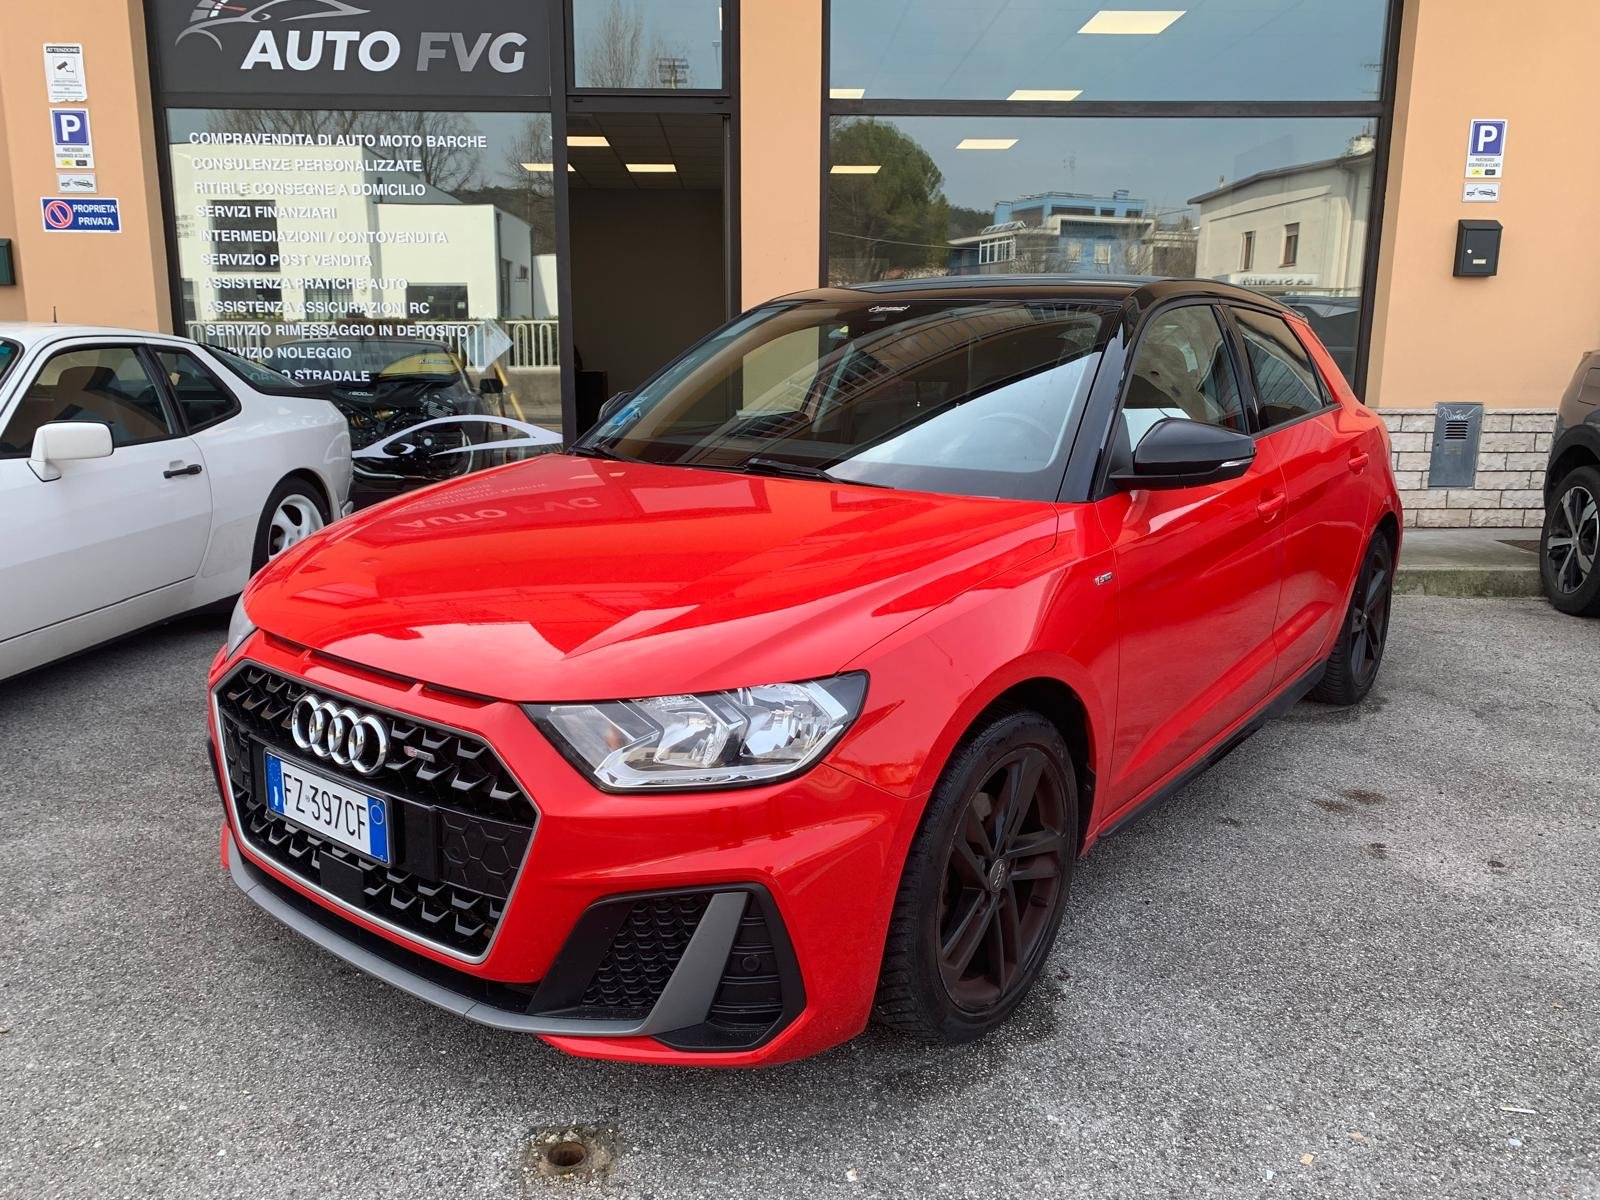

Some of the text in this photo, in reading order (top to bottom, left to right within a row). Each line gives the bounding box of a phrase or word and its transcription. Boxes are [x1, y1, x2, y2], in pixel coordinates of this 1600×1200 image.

[240, 30, 528, 73] AUTO FVG
[60, 114, 81, 142] P
[189, 132, 488, 148] COMPRAVENDITA DI AUTO MOTO BARCHE
[1477, 125, 1498, 152] P
[191, 157, 423, 172] CONSULENZE PERSONALIZZATE
[240, 183, 250, 195] E
[254, 183, 336, 196] CONSEGNE
[339, 183, 349, 196] A
[351, 183, 426, 196] DOMICILIO
[196, 205, 337, 219] SERVIZI FINANZIARI
[78, 216, 114, 226] PRIVATA
[200, 230, 326, 243] INTERMEDIAZIONI
[336, 231, 448, 244] CONTOVENDITA
[201, 253, 373, 267] SERVIZIO POST VENDITA
[205, 277, 409, 291] ASSISTENZA PRATICHE AUTO
[207, 301, 430, 315] ASSISTENZA ASSICURAZIONI RC
[207, 324, 469, 338] SERVIZIO RIMESSAGGIO IN DEPOSITO
[277, 347, 352, 360] NOLEGGIO
[294, 369, 371, 382] STRADALE
